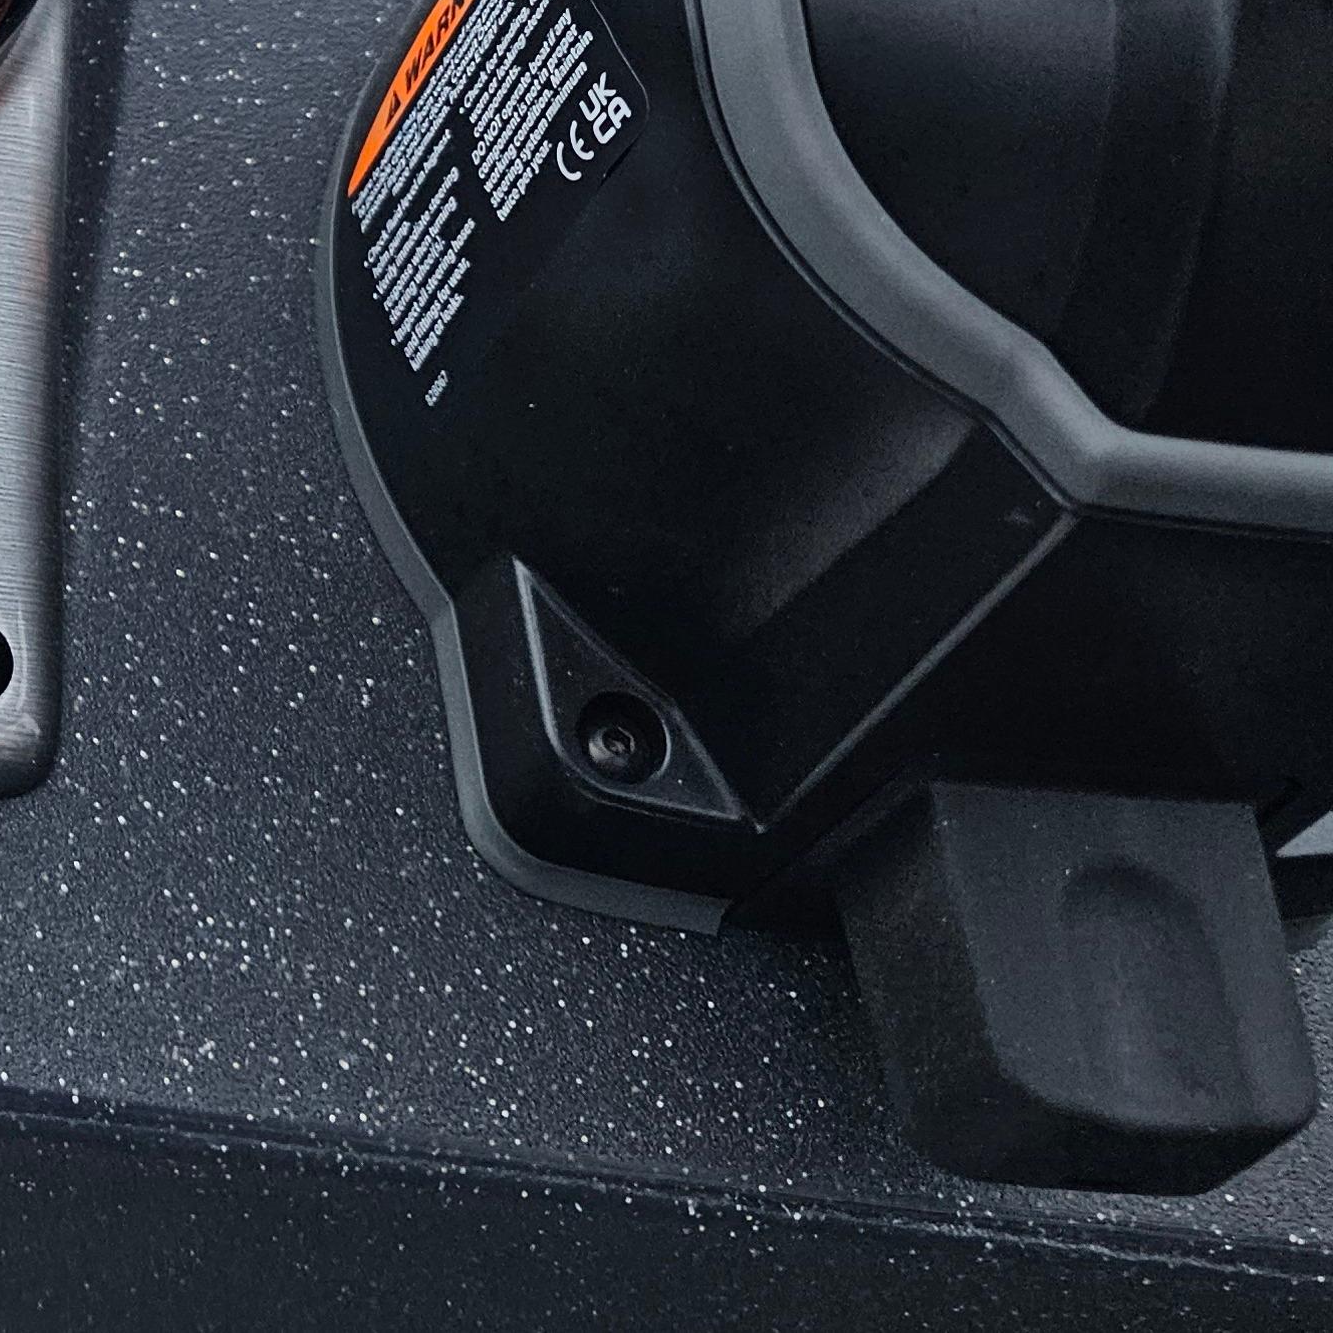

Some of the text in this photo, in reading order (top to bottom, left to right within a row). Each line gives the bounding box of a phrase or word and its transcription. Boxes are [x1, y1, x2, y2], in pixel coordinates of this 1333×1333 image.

[464, 72, 488, 108] Check
[486, 53, 497, 74] for
[469, 92, 489, 123] worn
[489, 77, 497, 94] or
[496, 34, 526, 80] leaking
[474, 20, 497, 63] EVERY
[472, 8, 571, 165] DO NOT operate boat if any
[474, 65, 521, 138] components.
[479, 24, 577, 178] component is not in proper
[484, 31, 593, 194] working condition. Maintain
[579, 72, 616, 130] UK
[593, 90, 631, 144] CA
[491, 51, 587, 213] steering system minimum
[368, 230, 389, 262] Check
[401, 179, 419, 210] level
[423, 129, 451, 174] highest
[497, 140, 552, 221] twice per year.
[372, 251, 390, 278] helm
[376, 167, 459, 294] Verify immediate steering
[384, 196, 457, 311] response when turning
[389, 281, 417, 324] steering
[394, 302, 421, 342] Inspect
[426, 249, 456, 294] steering
[451, 218, 475, 257] hoses
[404, 258, 470, 357] and fittings for wear,
[409, 328, 438, 371] kinking
[440, 294, 464, 323] leaks.
